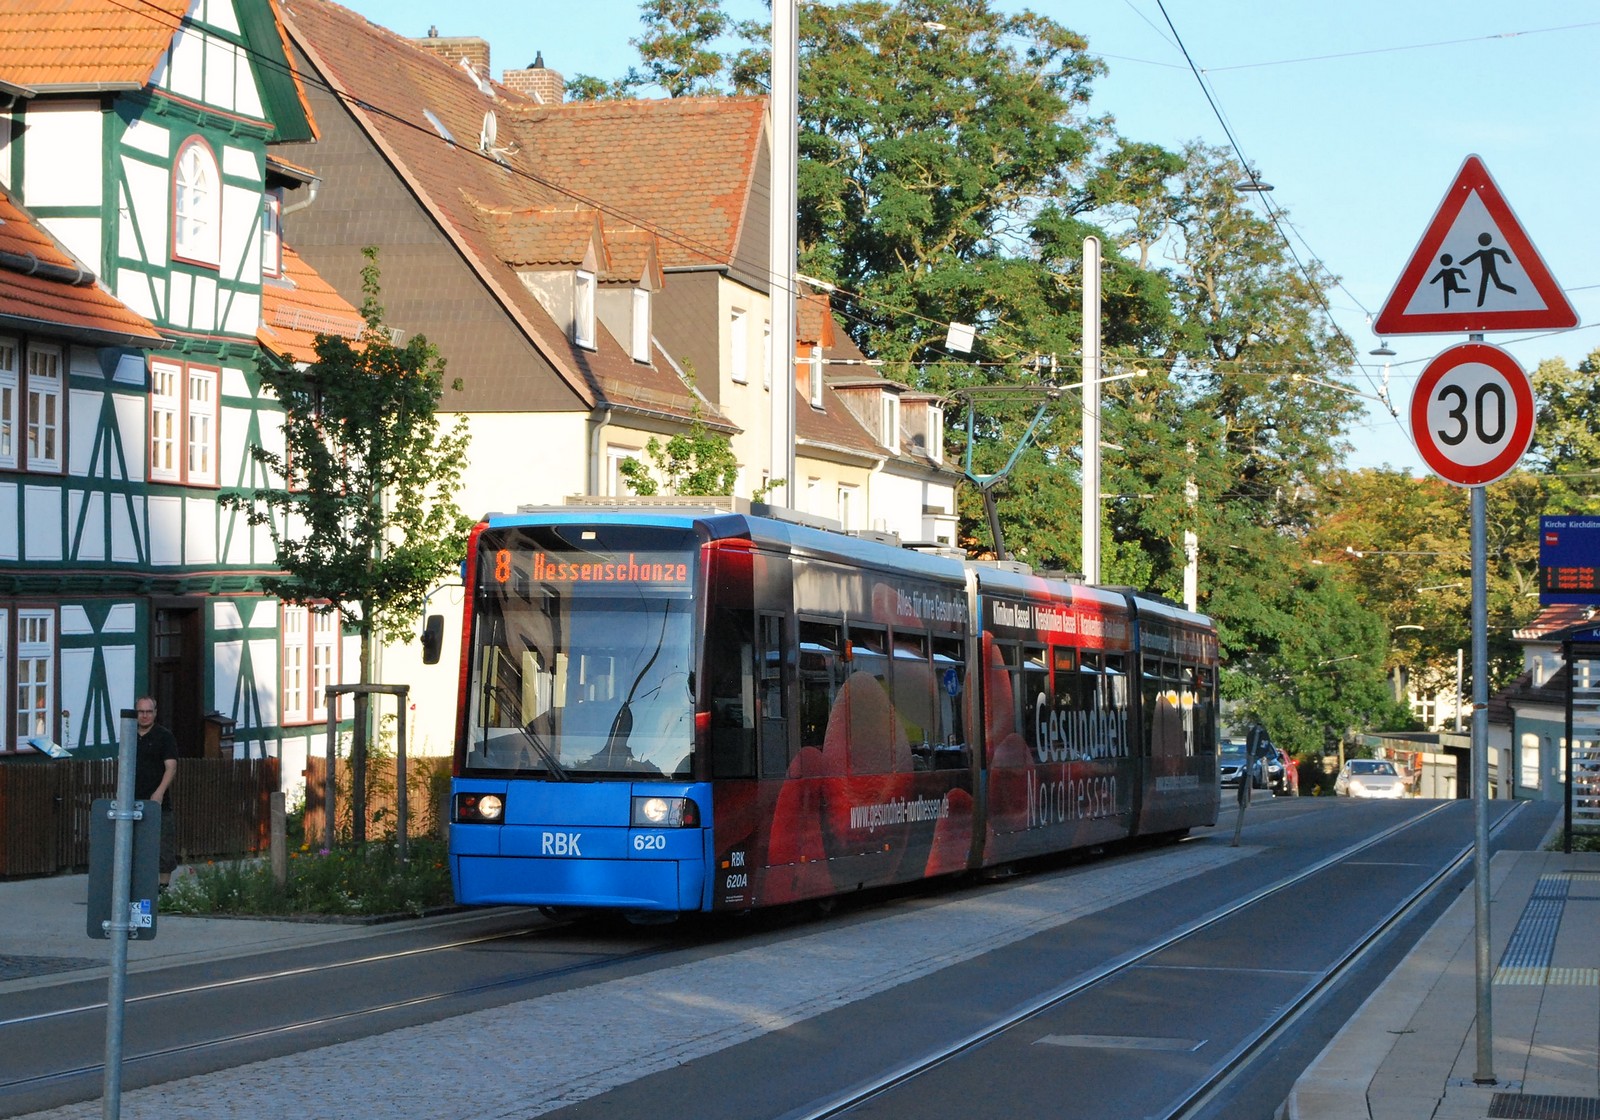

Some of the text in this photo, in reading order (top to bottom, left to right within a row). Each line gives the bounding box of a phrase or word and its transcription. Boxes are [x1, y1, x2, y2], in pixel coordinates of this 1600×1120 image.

[1437, 382, 1506, 446] 30
[1544, 520, 1567, 529] Kirche
[494, 548, 686, 583] 8 Hessenschanze
[896, 588, 912, 617] Alles
[1014, 603, 1031, 629] Kassel
[1062, 610, 1077, 634] Kassel
[1035, 688, 1129, 763] Gesundheit
[1027, 763, 1117, 827] Nordhessen
[850, 793, 950, 834] www.gesundheit-nordhessen.de
[541, 832, 582, 857] RBK
[633, 835, 666, 851] 620
[731, 852, 745, 868] RBK
[726, 873, 748, 889] 620A
[141, 916, 151, 925] KS
